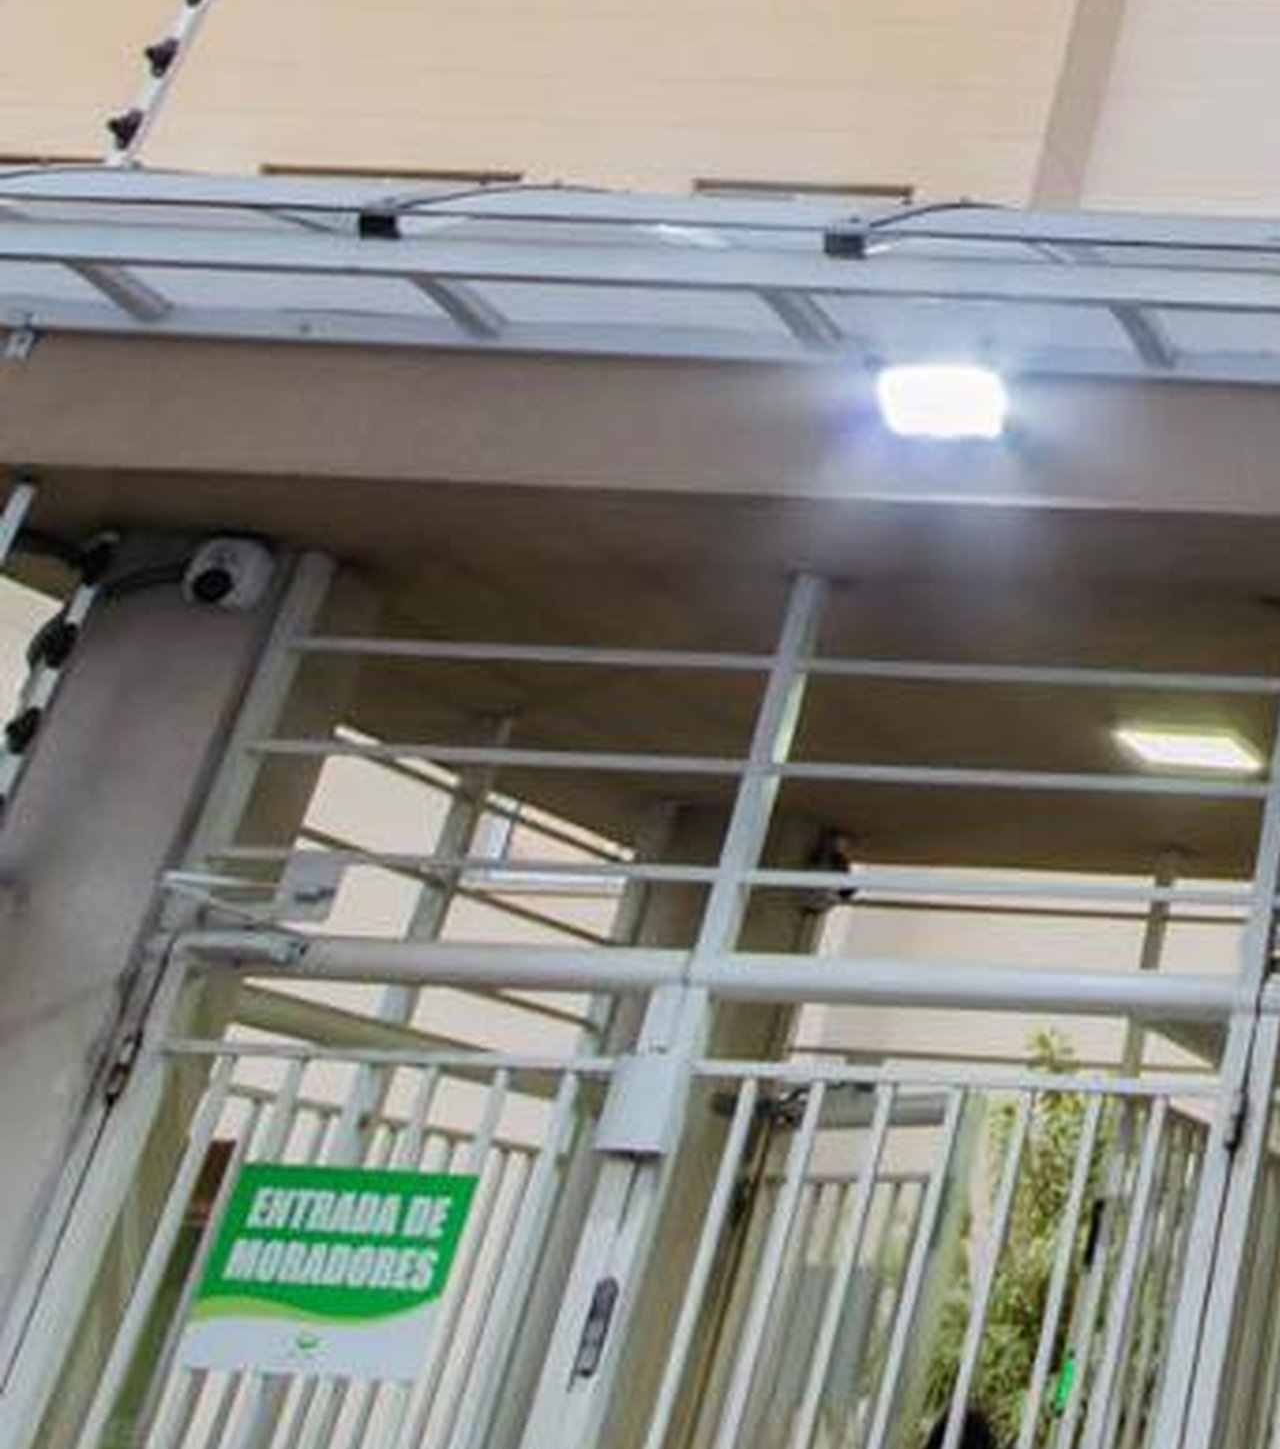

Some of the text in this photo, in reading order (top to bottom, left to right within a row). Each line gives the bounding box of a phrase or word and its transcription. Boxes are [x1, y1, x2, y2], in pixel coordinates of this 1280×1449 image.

[246, 1187, 451, 1238] ENTRADA DE
[223, 1238, 438, 1289] MORADORES
